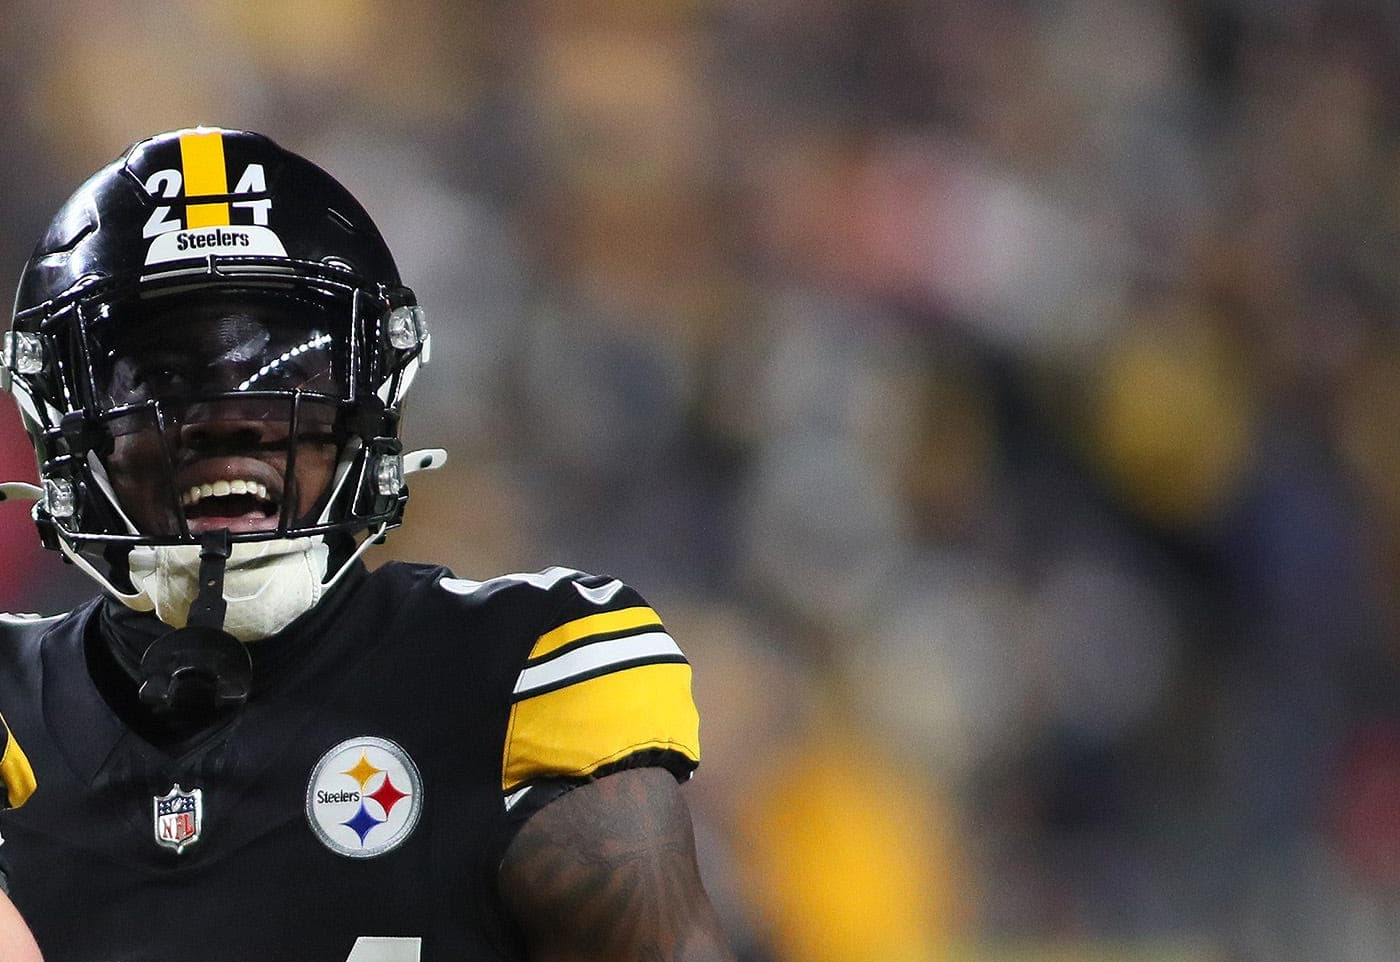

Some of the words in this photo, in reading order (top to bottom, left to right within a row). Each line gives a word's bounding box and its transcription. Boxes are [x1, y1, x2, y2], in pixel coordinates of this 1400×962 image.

[177, 229, 250, 251] Steelers
[317, 789, 361, 804] Steelers
[162, 814, 194, 839] NFL
